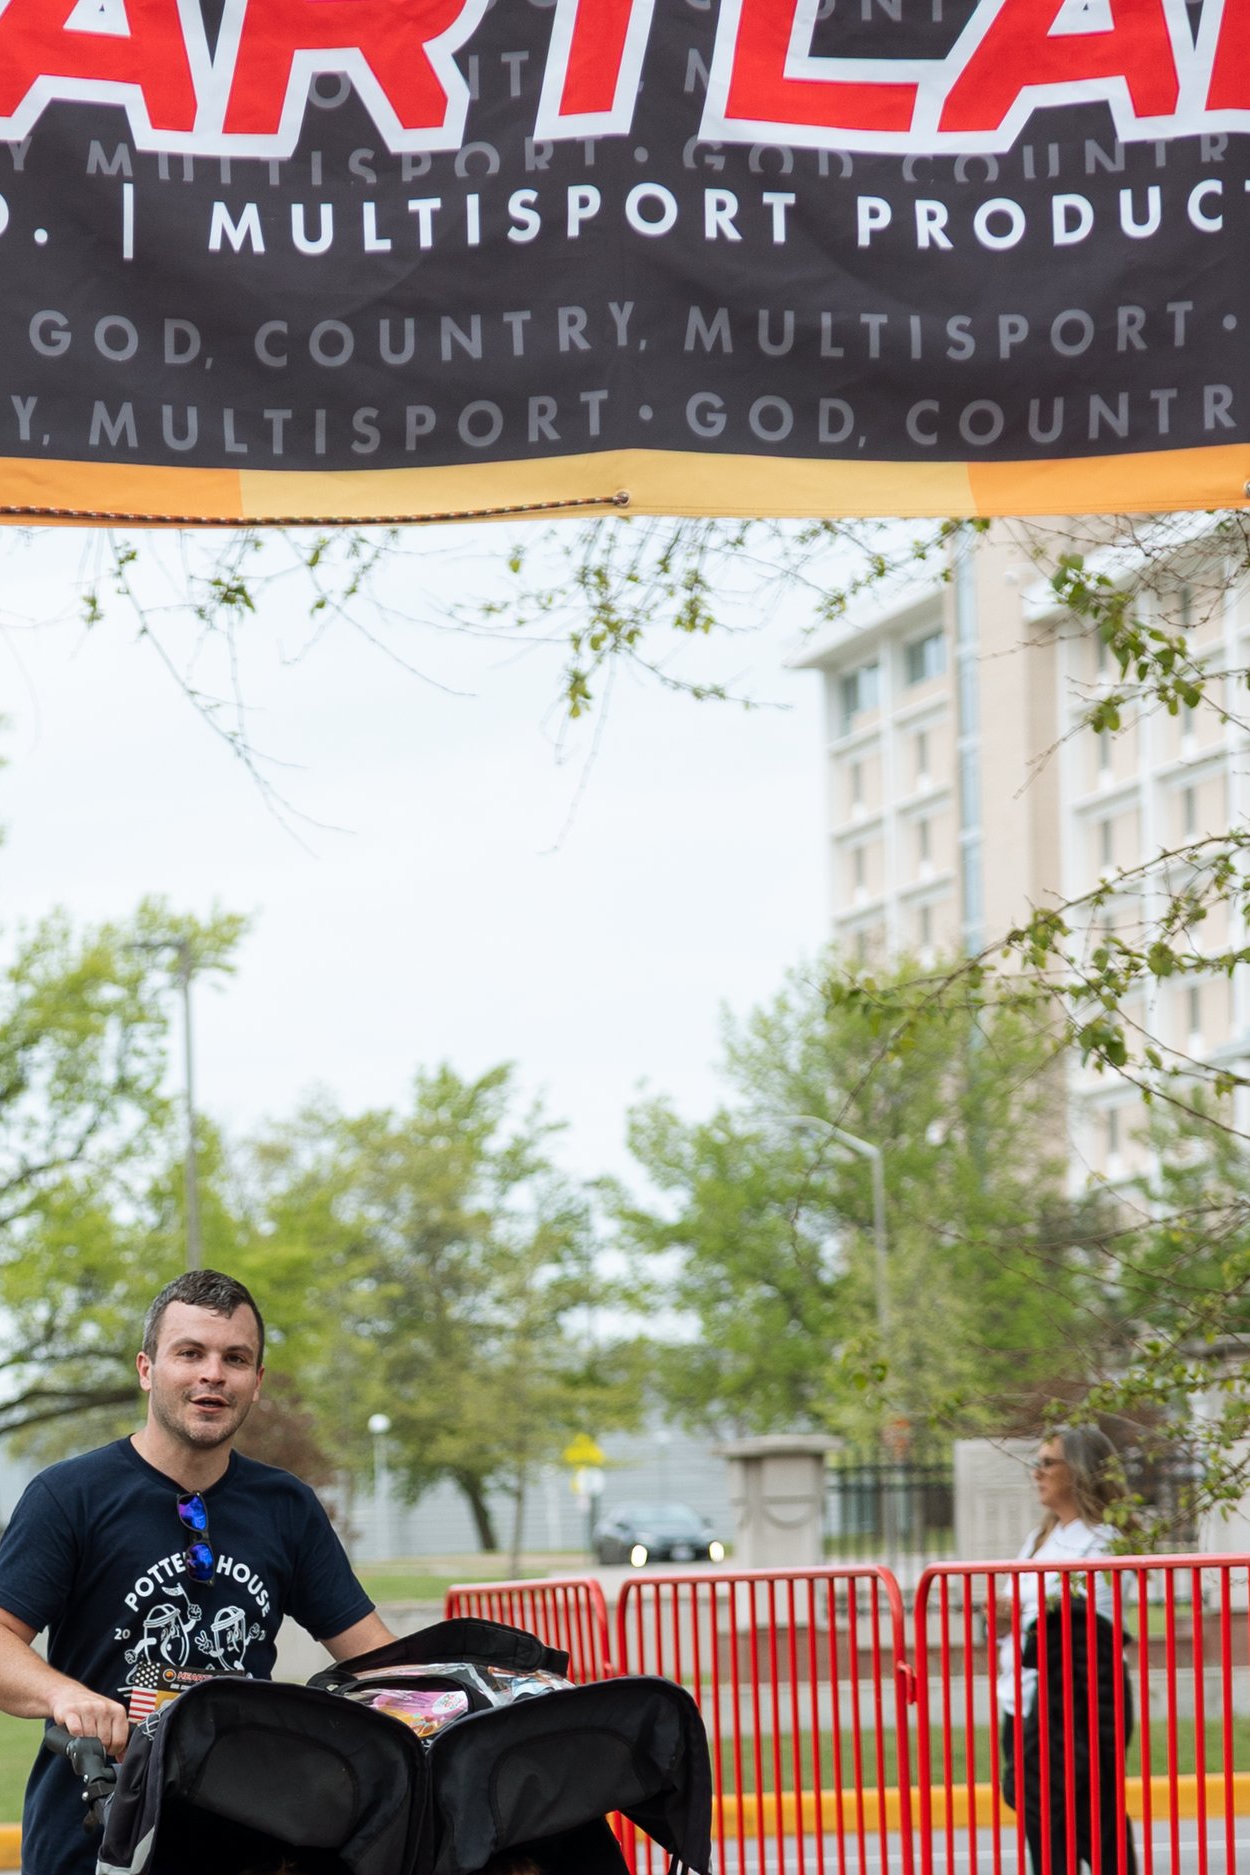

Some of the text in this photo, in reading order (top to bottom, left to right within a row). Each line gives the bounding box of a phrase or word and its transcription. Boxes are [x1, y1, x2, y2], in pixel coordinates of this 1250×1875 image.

[208, 181, 797, 256] MULTISPORT
[856, 178, 1250, 251] PRODUC
[28, 309, 213, 370] GOD,
[254, 301, 648, 368] COUNTRY,
[684, 300, 1193, 361] MULTISPORT
[89, 390, 609, 455] MULTISPORT
[685, 391, 866, 449] GOD,
[124, 1552, 270, 1618] POTTE HOUSE
[114, 1628, 131, 1640] 20
